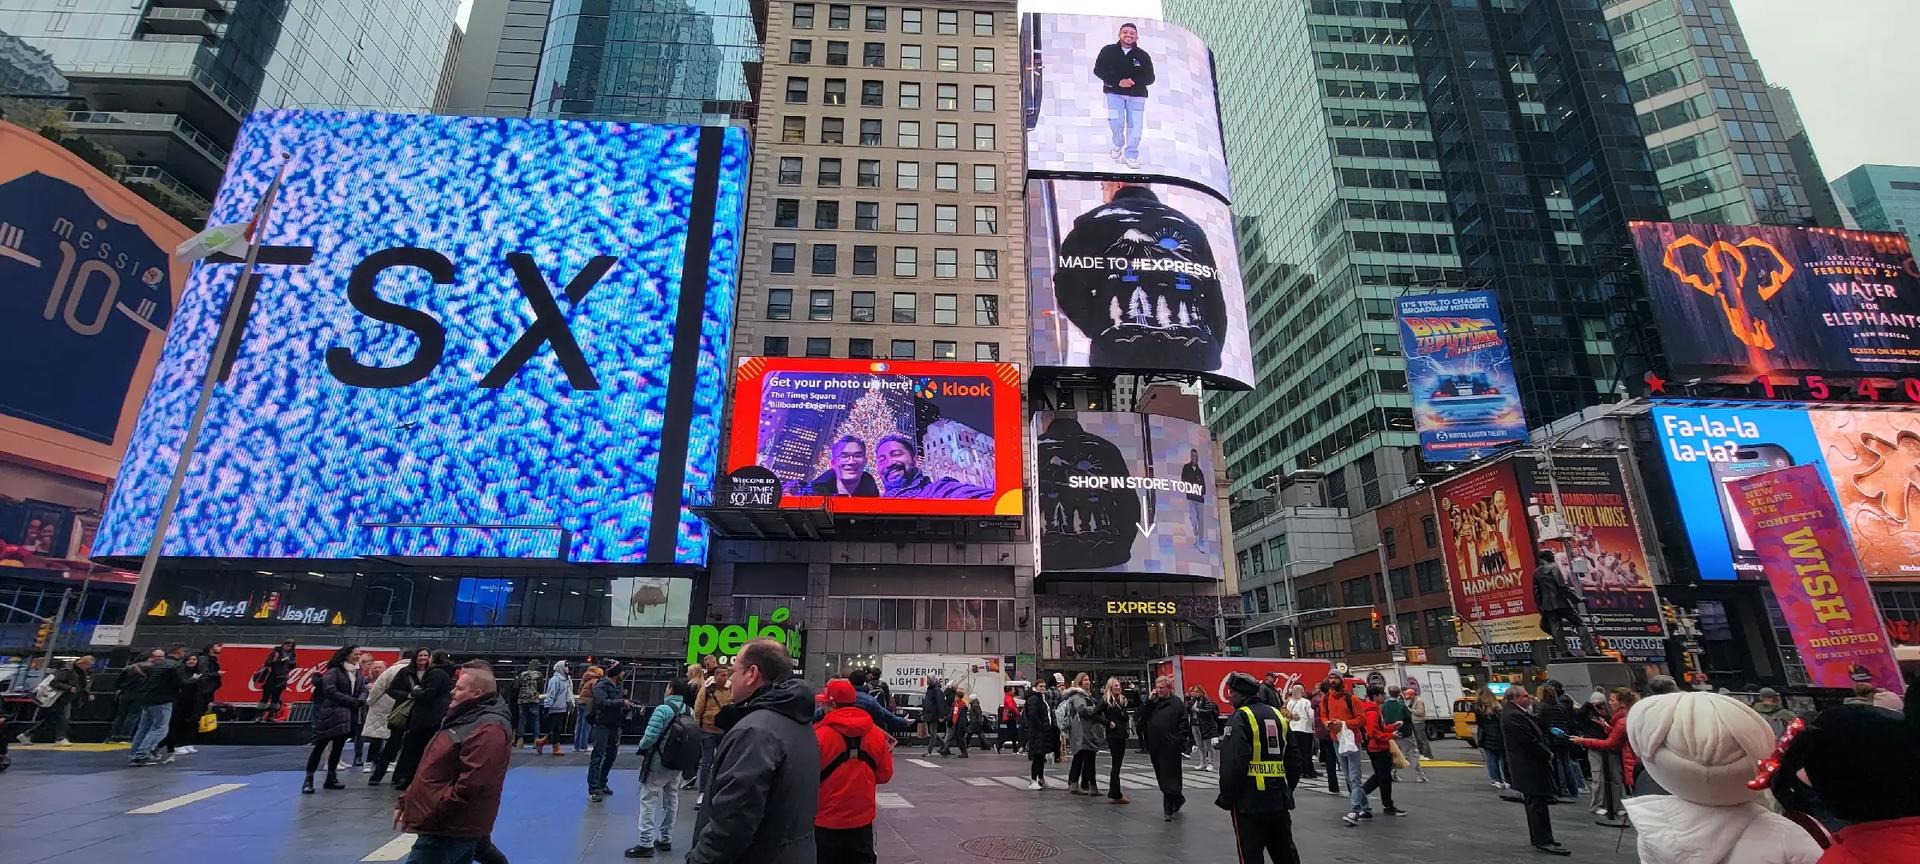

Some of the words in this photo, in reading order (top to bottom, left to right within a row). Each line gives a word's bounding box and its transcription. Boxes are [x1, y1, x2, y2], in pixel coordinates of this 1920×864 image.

[1059, 256, 1104, 269] MADE
[1107, 257, 1128, 270] TO
[1813, 267, 1878, 276] FEBRUARY
[43, 240, 121, 335] 10
[1828, 281, 1898, 301] WATER
[1402, 305, 1449, 314] BROADWAY
[1450, 302, 1489, 311] HISTORY!
[1417, 299, 1438, 307] TIME
[1452, 296, 1488, 304] CHANGE
[1861, 302, 1880, 310] FOR
[204, 245, 618, 390] TSX
[1401, 316, 1496, 337] BACK
[1434, 329, 1503, 352] FUTURE
[1877, 331, 1910, 340] MUSICAL
[769, 377, 792, 388] Get
[793, 379, 823, 391] your
[824, 378, 859, 391] photo
[882, 379, 913, 391] here!
[942, 382, 991, 397] klook
[771, 391, 785, 400] The
[786, 391, 809, 400] Times
[810, 392, 837, 402] Square
[770, 401, 804, 410] Billboard
[1662, 414, 1760, 438] Fa-la-la
[1669, 438, 1738, 462] la-la?
[1068, 476, 1108, 488] SHOP
[1110, 476, 1124, 489] IN
[1126, 477, 1170, 490] STORE
[1170, 480, 1203, 496] TODAY
[1744, 486, 1773, 499] NEW
[1746, 492, 1792, 507] YEAR'S
[1543, 505, 1598, 527] BEUTIFUL
[1596, 505, 1629, 527] NOISE
[1752, 504, 1777, 515] EVE
[1758, 510, 1824, 528] CONFETTI
[1782, 526, 1851, 624] WISH
[1462, 570, 1523, 596] HARMONY
[1106, 601, 1177, 614] EXPRESS
[1608, 639, 1665, 650] LUGGAGE
[1808, 632, 1879, 648] DROPPED
[1482, 642, 1532, 655] UGGAGE
[890, 677, 917, 686] LIGHT
[1250, 763, 1275, 775] PUBLIC
